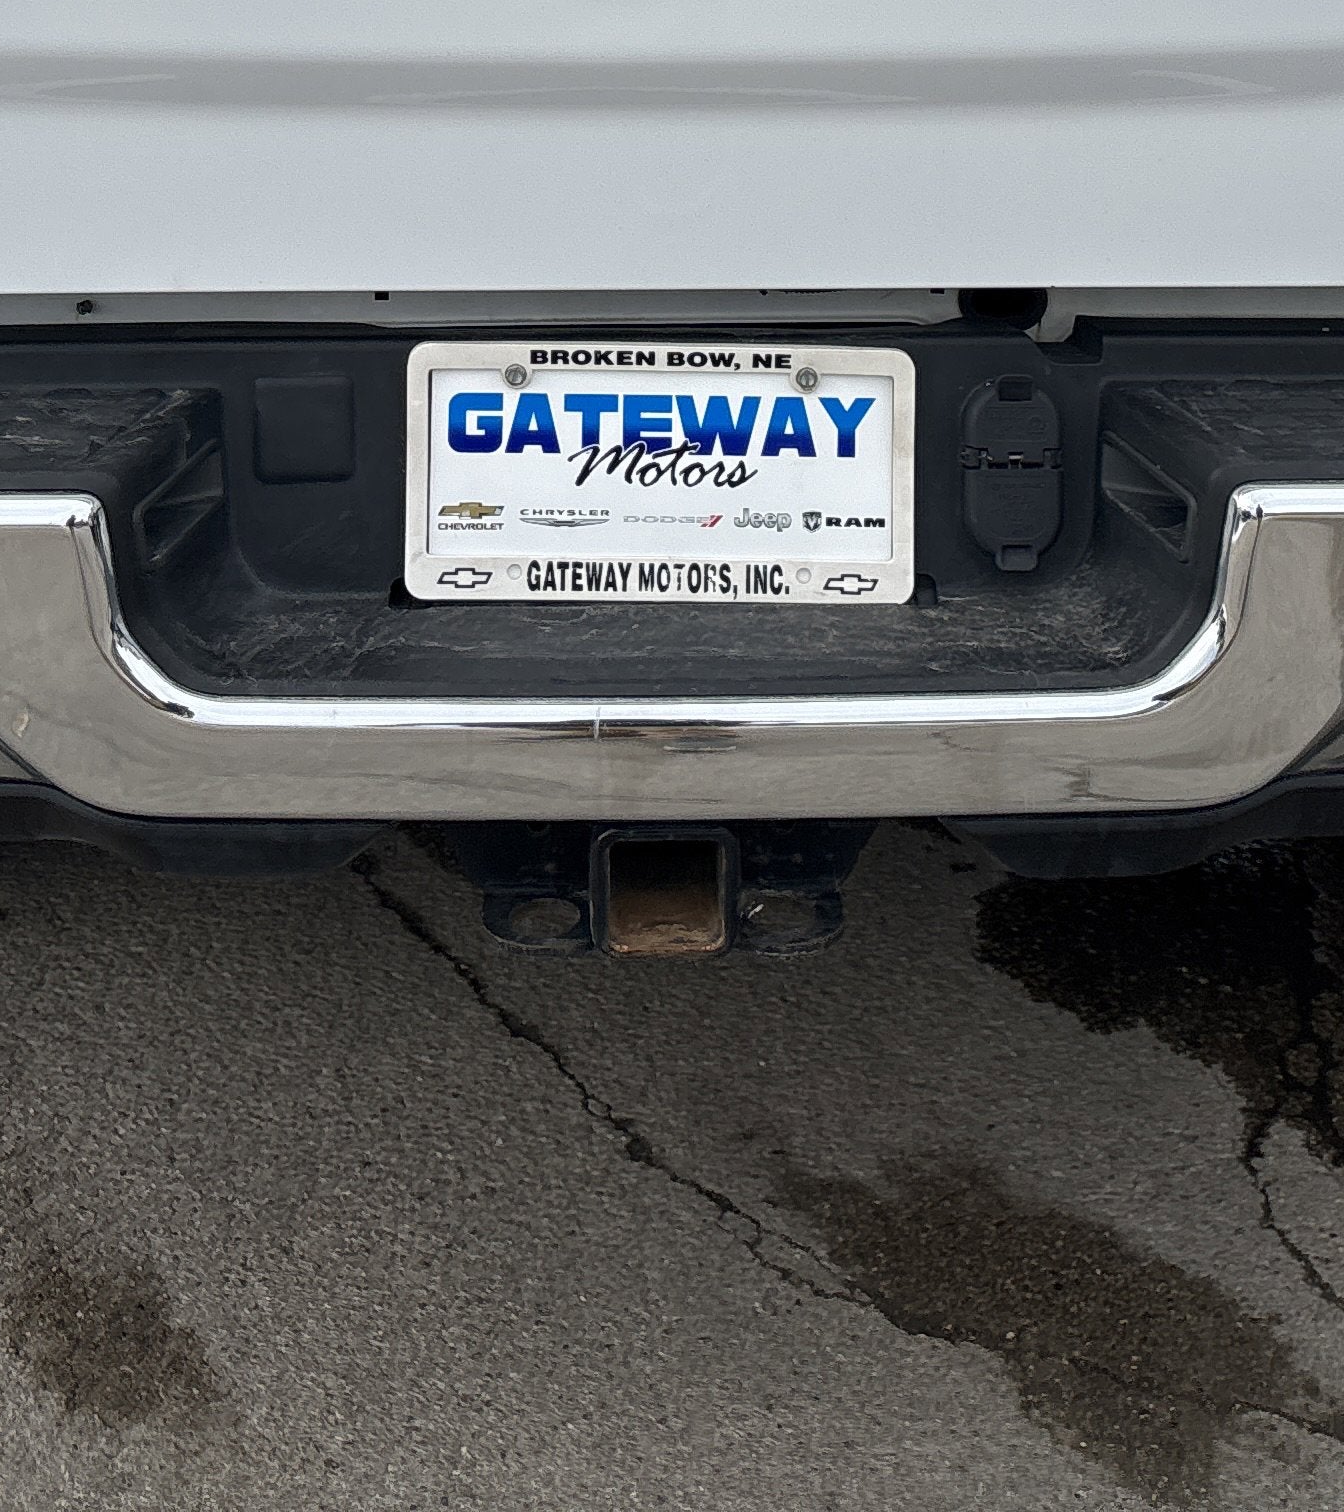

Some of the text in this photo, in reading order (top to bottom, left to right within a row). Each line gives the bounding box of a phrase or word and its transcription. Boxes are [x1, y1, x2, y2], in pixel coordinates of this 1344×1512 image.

[530, 349, 792, 371] BROKEN BOW, NE
[447, 392, 877, 458] GATEWAY
[567, 440, 759, 488] Motors
[437, 522, 504, 531] CHEVROLET
[519, 508, 610, 517] CHRYSLER
[734, 508, 792, 532] Jeep
[825, 517, 886, 528] RAM
[526, 559, 790, 600] GATEWAY MOTORS, INC.
